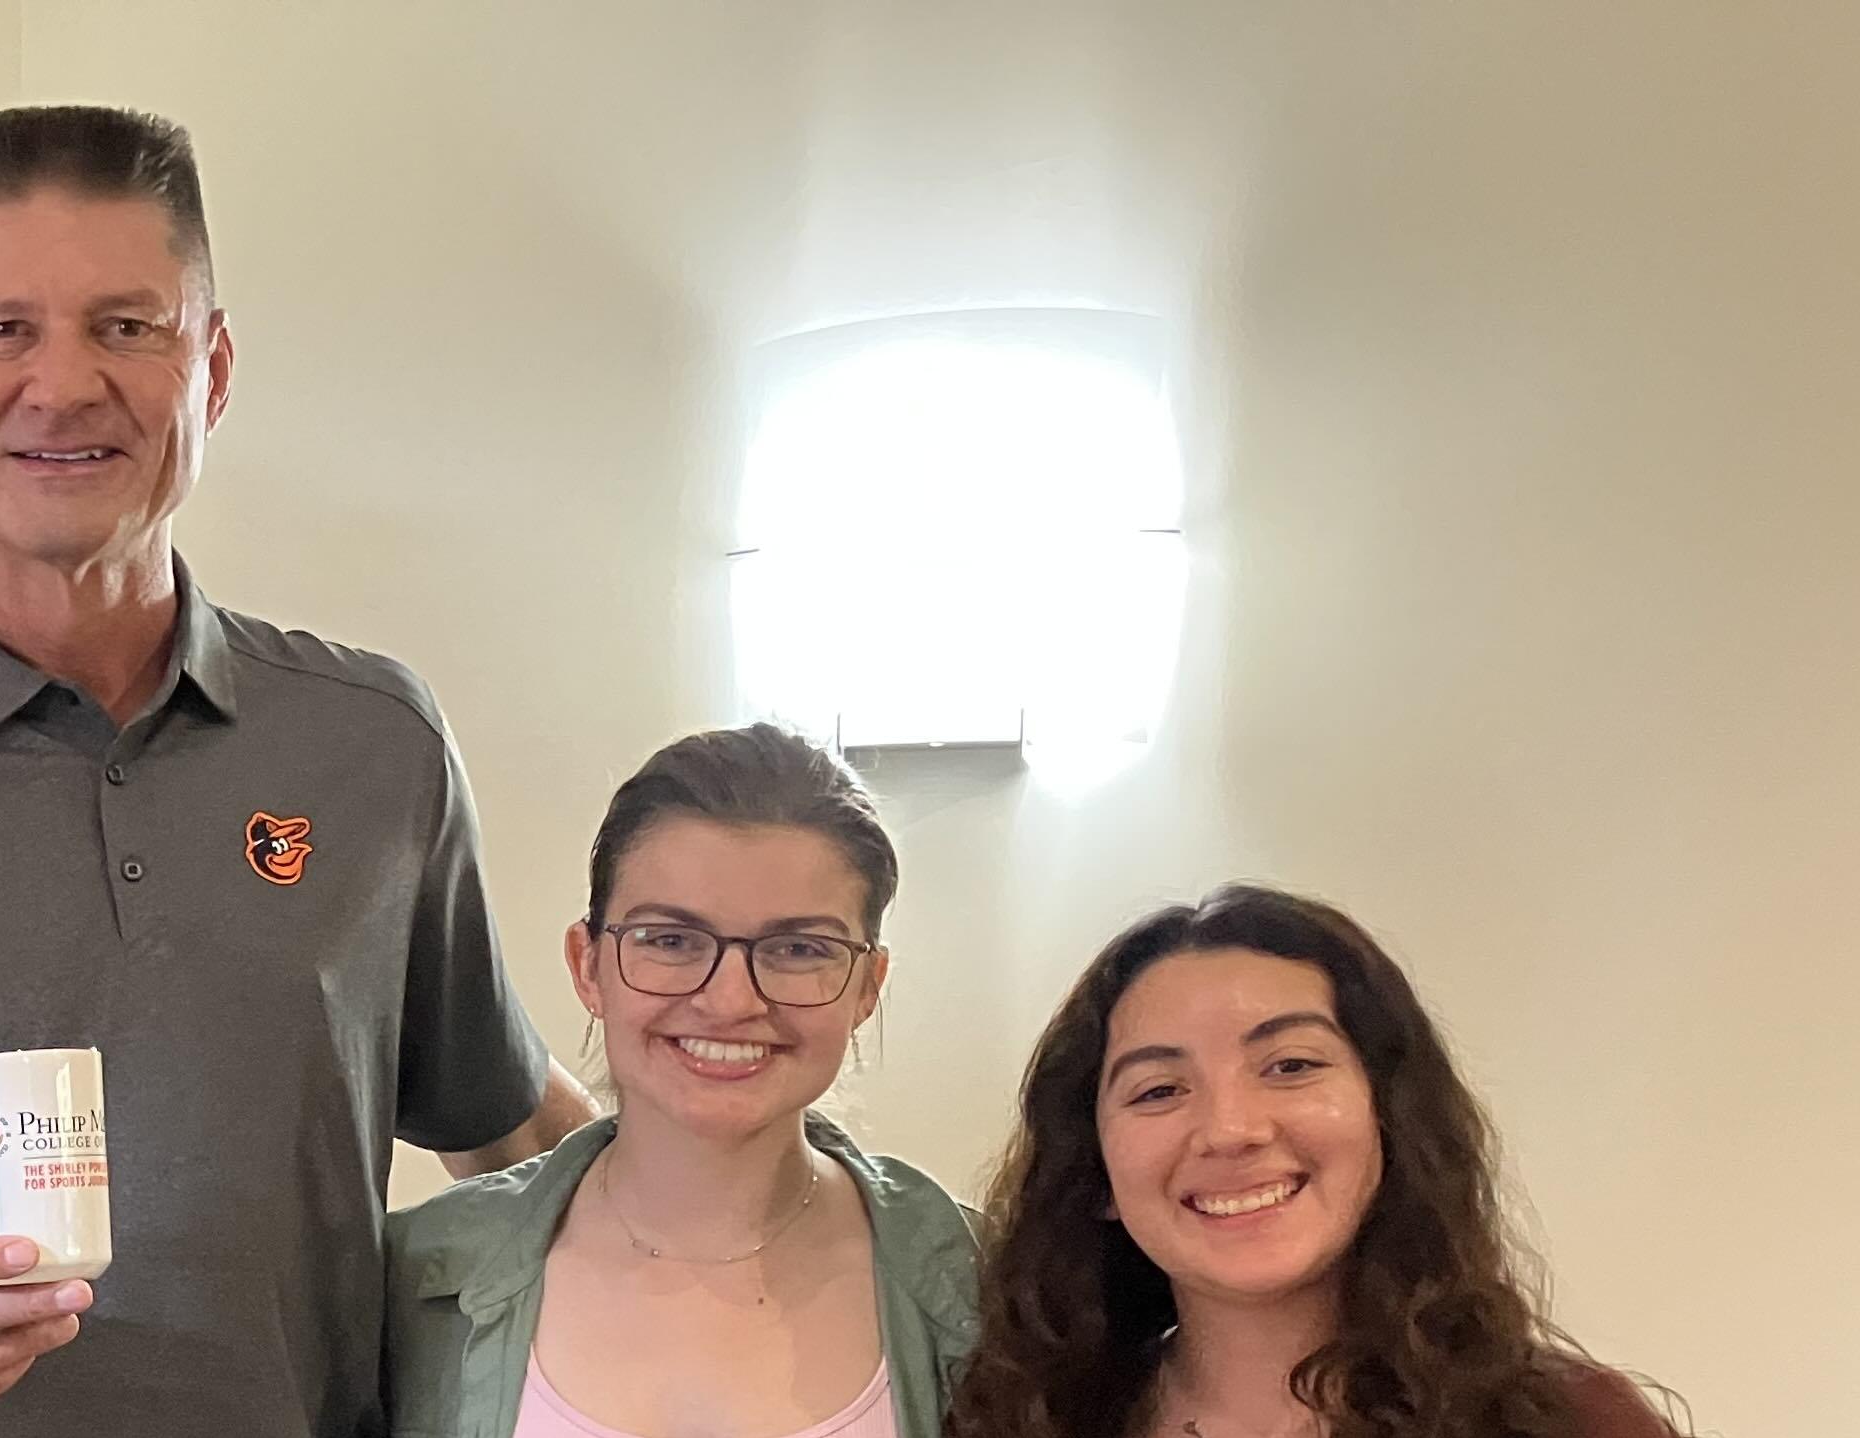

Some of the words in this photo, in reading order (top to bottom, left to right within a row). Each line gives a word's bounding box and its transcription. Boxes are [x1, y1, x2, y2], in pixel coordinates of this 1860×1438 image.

[17, 1111, 86, 1135] PHILIP
[22, 1136, 91, 1151] COLLEGE
[24, 1164, 44, 1177] THE
[48, 1162, 86, 1176] SHIRLEY
[25, 1178, 46, 1190] FOR
[50, 1176, 85, 1189] SPORTS
